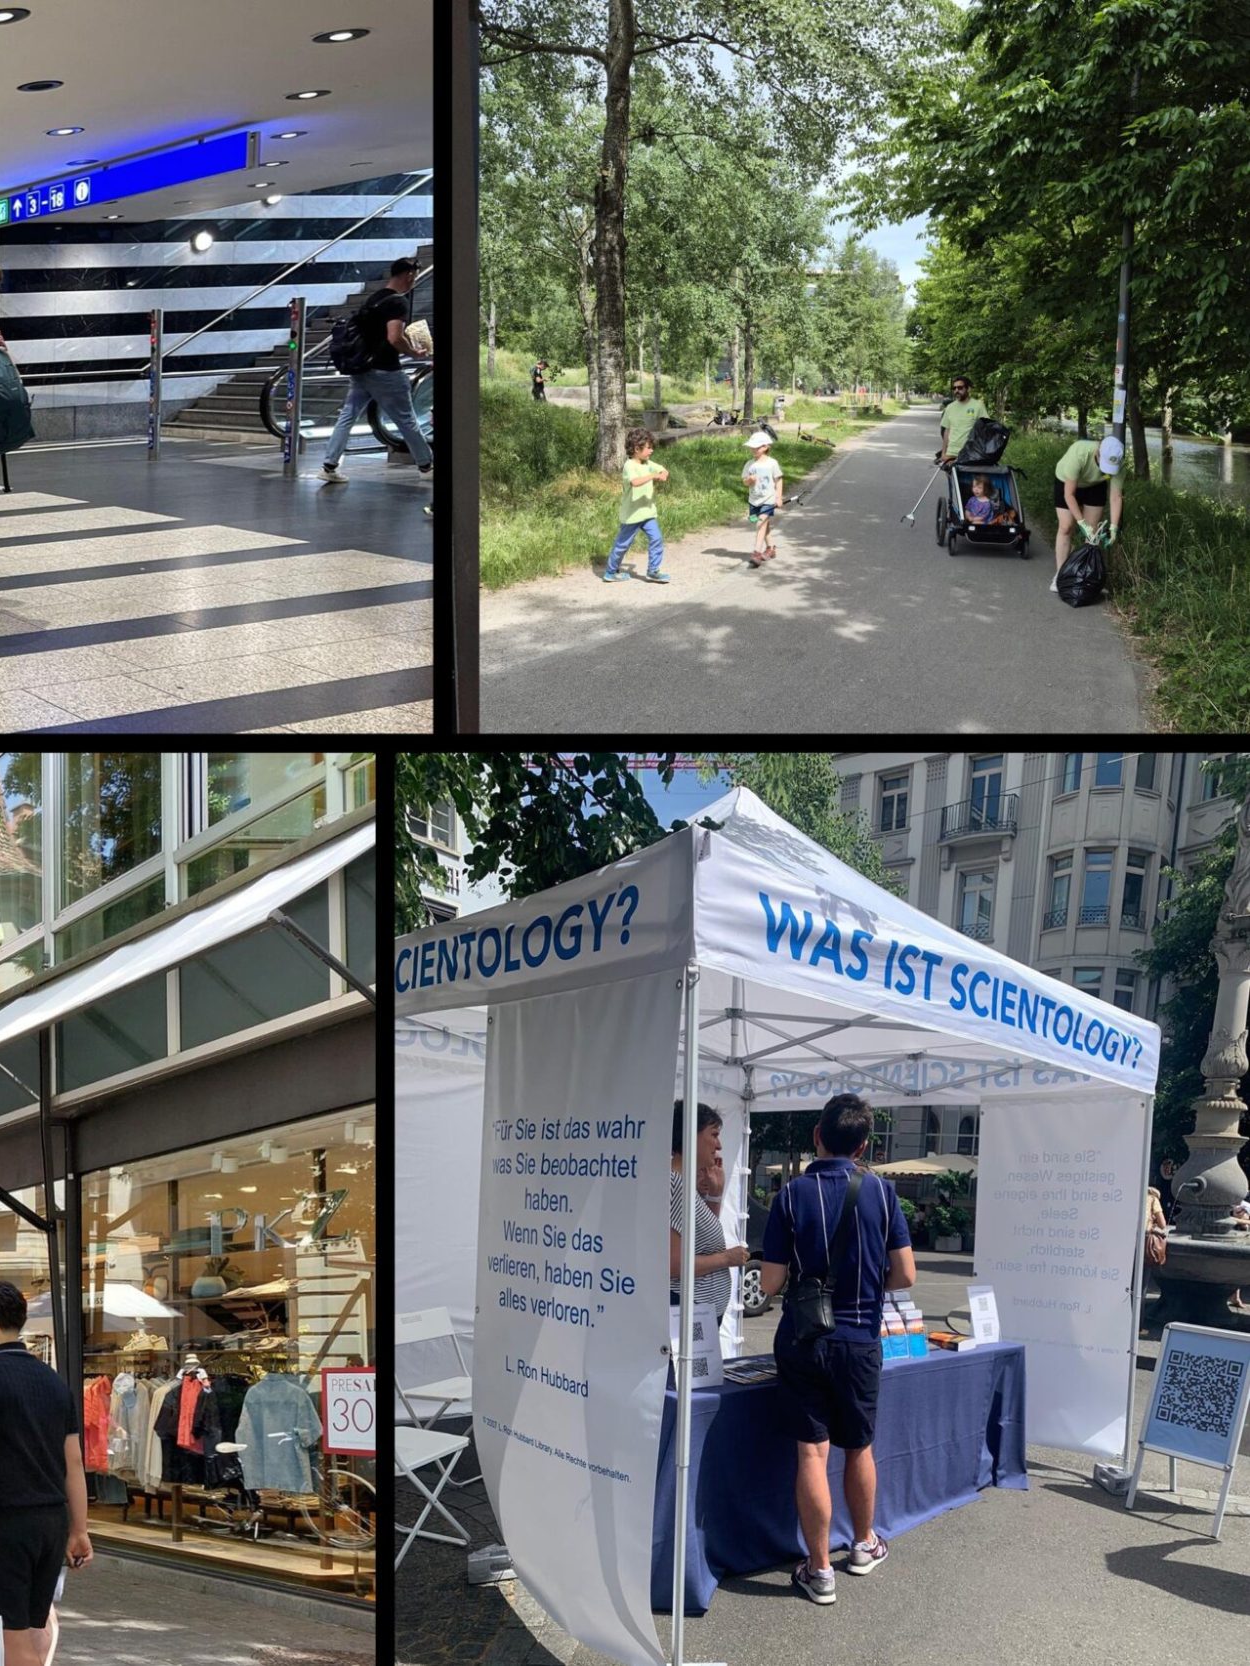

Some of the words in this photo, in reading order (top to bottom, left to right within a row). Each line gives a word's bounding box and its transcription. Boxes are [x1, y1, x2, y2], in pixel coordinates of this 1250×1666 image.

[395, 884, 640, 993] CIENTOLOGY?
[758, 891, 874, 982] WAS
[883, 940, 944, 1001] IST
[948, 963, 1144, 1069] SCIENTOLOGY?
[515, 1118, 536, 1141] Sie
[541, 1117, 561, 1140] ist
[564, 1116, 590, 1140] das
[597, 1114, 646, 1140] wahr
[492, 1155, 512, 1174] was
[515, 1152, 536, 1175] Sie
[540, 1152, 638, 1179] beobachtet
[524, 1187, 574, 1213] haben.
[209, 1187, 350, 1257] PKZ
[503, 1219, 538, 1246] Wenn
[542, 1224, 567, 1249] Sie
[572, 1227, 604, 1254] das
[487, 1253, 540, 1286] verlieren,
[544, 1260, 593, 1290] haben
[600, 1267, 636, 1296] Sie
[499, 1287, 527, 1312] alles
[505, 1355, 515, 1374] L.
[517, 1359, 538, 1382] Ron
[541, 1366, 589, 1398] Hubbard
[332, 1397, 374, 1433] 30
